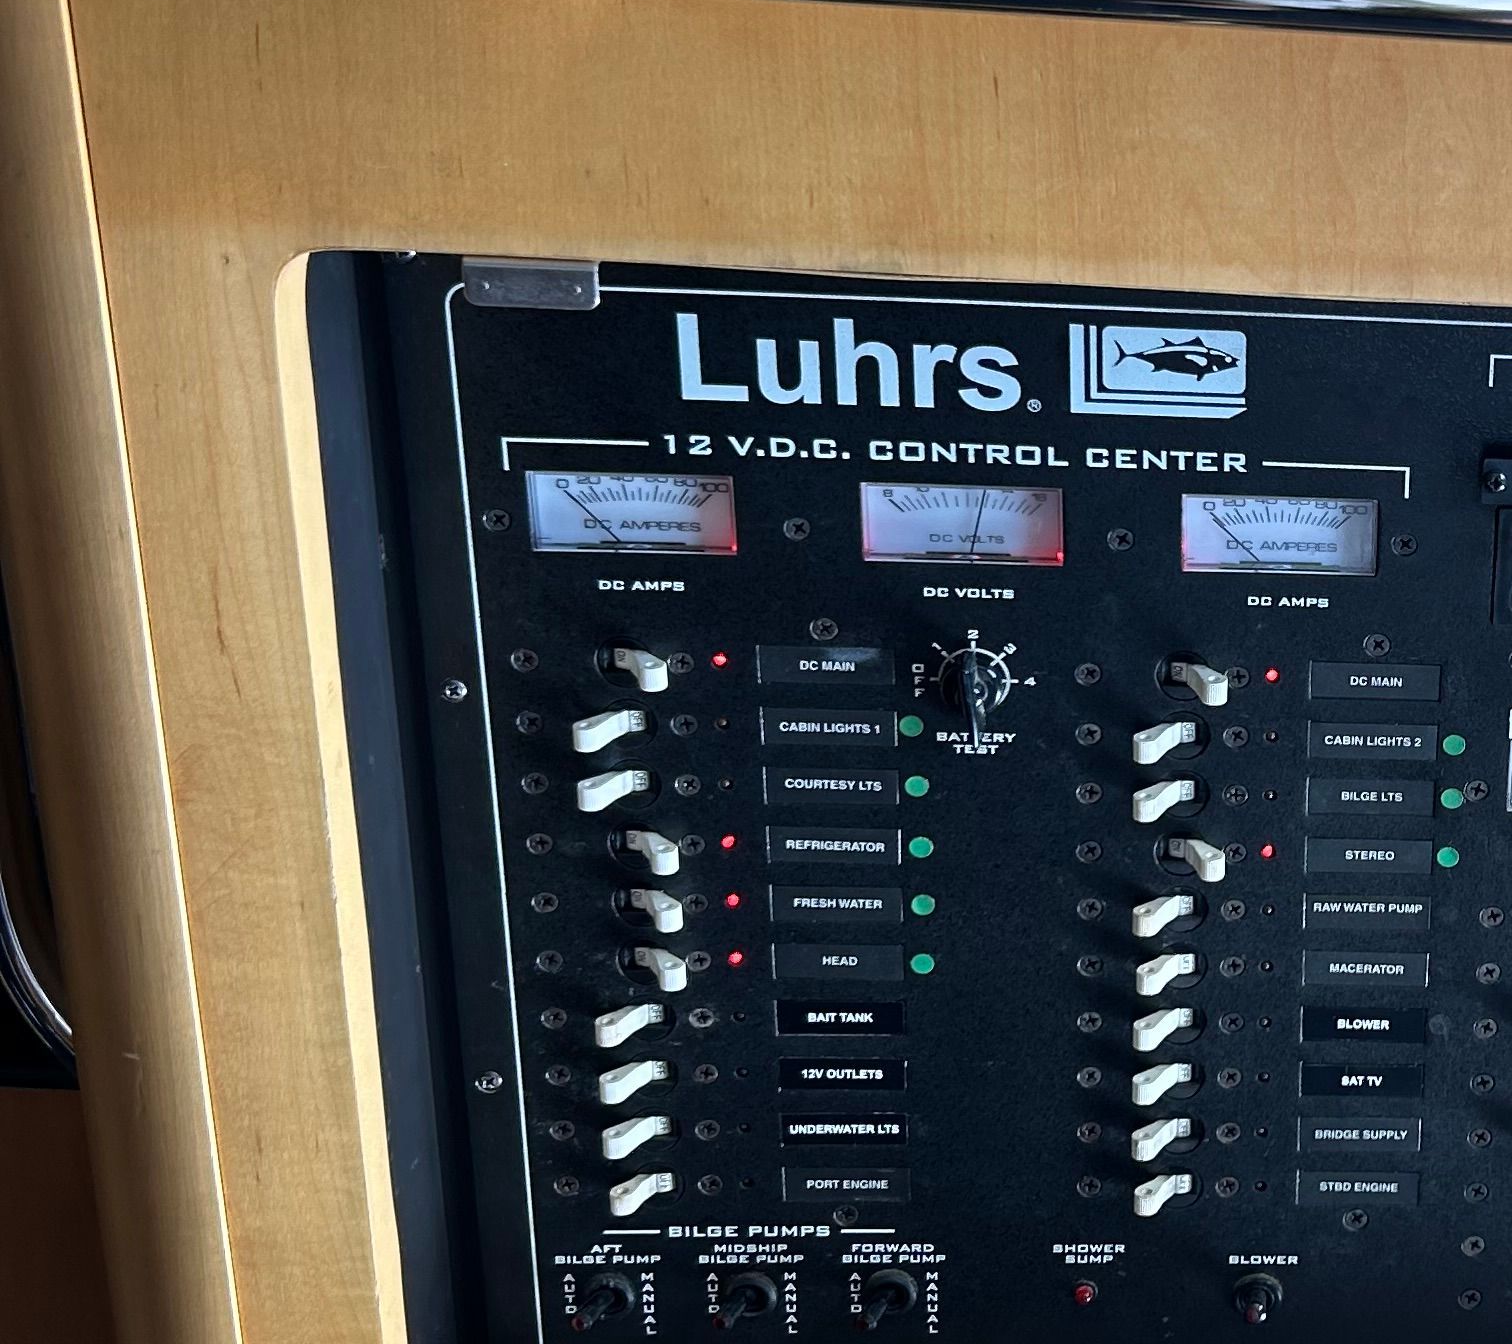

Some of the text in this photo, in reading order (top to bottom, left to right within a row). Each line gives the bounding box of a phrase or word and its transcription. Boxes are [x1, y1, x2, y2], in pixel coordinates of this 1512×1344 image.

[676, 313, 1022, 412] Luhrs
[663, 435, 1247, 472] 12 V.D.C. CONTROL CENTER
[598, 580, 685, 592] DC AMPS
[923, 587, 1015, 599] DC VOLTS
[1248, 596, 1329, 607] DC AMPS
[800, 660, 855, 672] DC MAIN
[1350, 676, 1402, 687] DC MAIN
[779, 721, 881, 734] CABIN LIGHTS 1
[1324, 735, 1422, 747] CABIN LIGHTS 2
[784, 778, 882, 791] COURTESY LTS
[1341, 791, 1402, 802] BILGE LTS
[786, 839, 885, 853] REFRIGERATOR
[1345, 850, 1395, 861] STEREO
[793, 898, 883, 909] FRESH WATER
[1313, 902, 1423, 914] RAW WATER PUMP
[822, 956, 858, 966] HEAD
[1329, 963, 1404, 975] MACERATOR
[807, 1013, 873, 1023] BAIT TANK
[1337, 1019, 1389, 1030] BLOWER
[801, 1069, 883, 1080] 12V OUTLETS
[789, 1124, 899, 1134] UNDERWATER LTS
[1315, 1129, 1408, 1141] BRIDGE SUPPLY
[807, 1179, 889, 1190] PORT ENGINE
[1319, 1181, 1398, 1193] STBD ENGINE
[668, 1225, 830, 1238] BILGE PUMPS
[590, 1244, 622, 1253] AFT
[714, 1244, 788, 1253] MIDSHIP
[852, 1243, 934, 1252] FORWARD
[1053, 1244, 1125, 1253] SHOWER
[555, 1255, 661, 1264] BILGE PUMP
[698, 1255, 804, 1264] BILGE PUMP
[842, 1254, 946, 1263] BILGE PUMP
[1065, 1255, 1113, 1264] SUMP
[1229, 1255, 1298, 1265] BLOWER
